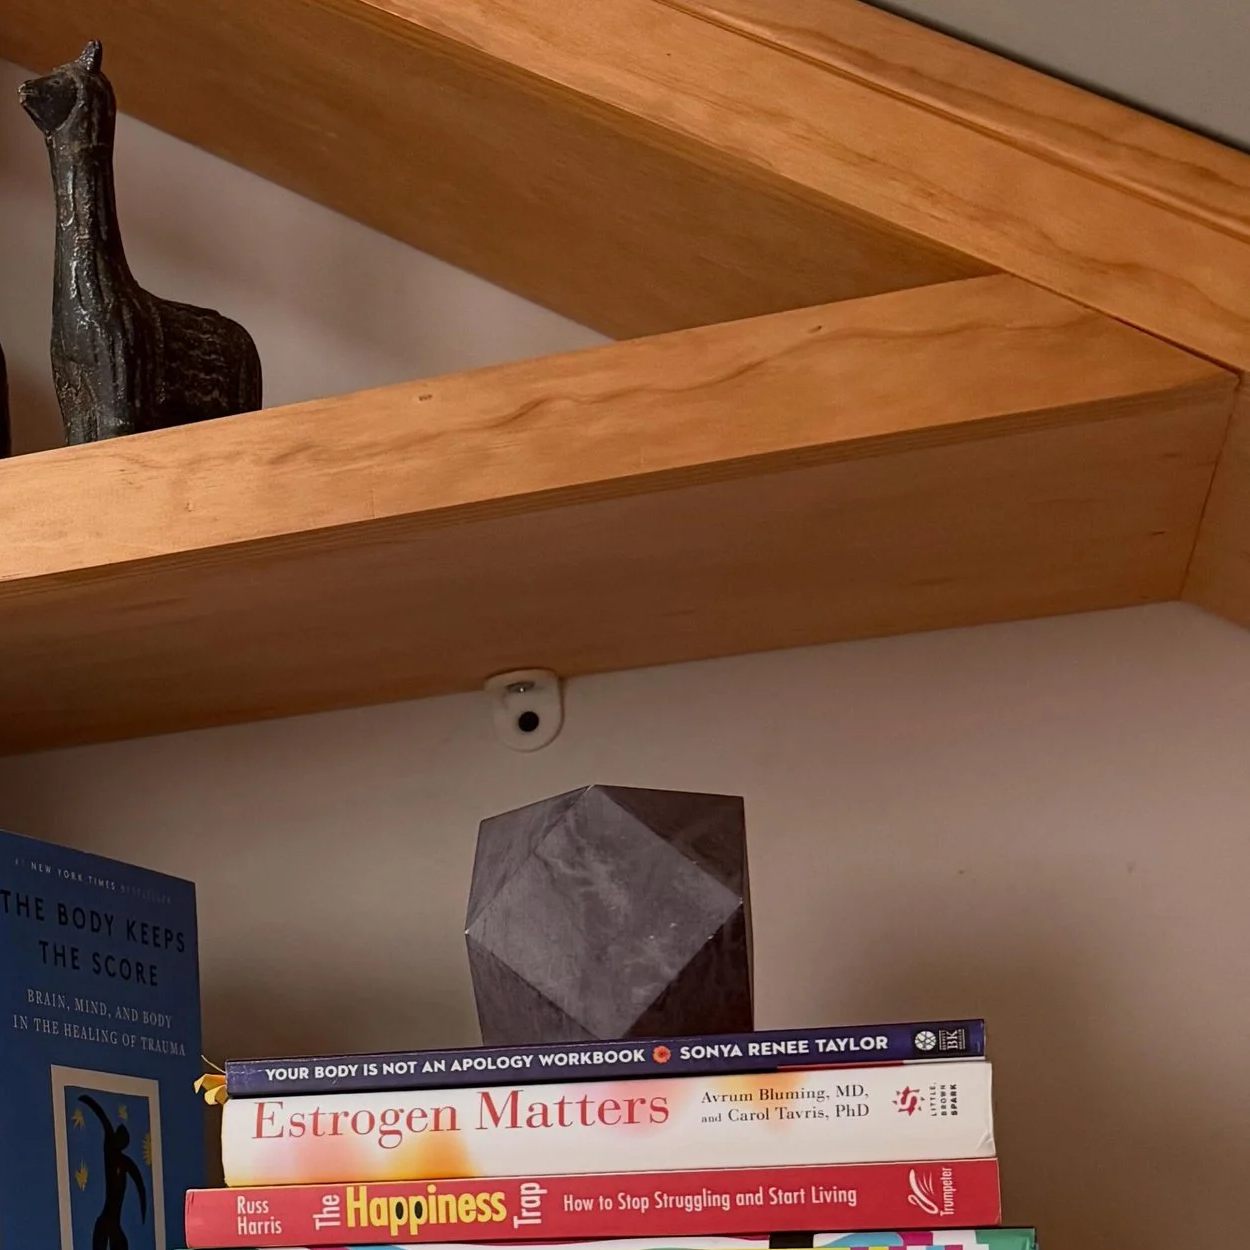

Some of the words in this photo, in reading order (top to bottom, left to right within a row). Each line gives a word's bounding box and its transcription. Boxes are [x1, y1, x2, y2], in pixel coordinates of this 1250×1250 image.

[266, 1067, 309, 1080] YOUR
[315, 1064, 355, 1079] BODY
[364, 1063, 378, 1075] IS
[383, 1062, 415, 1075] NOT
[422, 1060, 446, 1073] AN
[451, 1055, 532, 1072] APOLOGY
[538, 1048, 646, 1068] WORKBOOK
[680, 1043, 742, 1060] SONYA
[749, 1040, 809, 1056] RENEE
[816, 1035, 888, 1053] TAYLOR
[702, 1090, 753, 1104] Avrum
[759, 1087, 830, 1102] Bluming,
[836, 1084, 869, 1099] MD,
[251, 1101, 461, 1149] Estrogen
[474, 1088, 670, 1130] Matters
[237, 1196, 269, 1213] Russ
[313, 1194, 340, 1230] The
[346, 1185, 507, 1235] Happiness
[513, 1182, 547, 1229] Trap
[941, 1167, 954, 1216] Trumpeter
[238, 1216, 282, 1235] Harris
